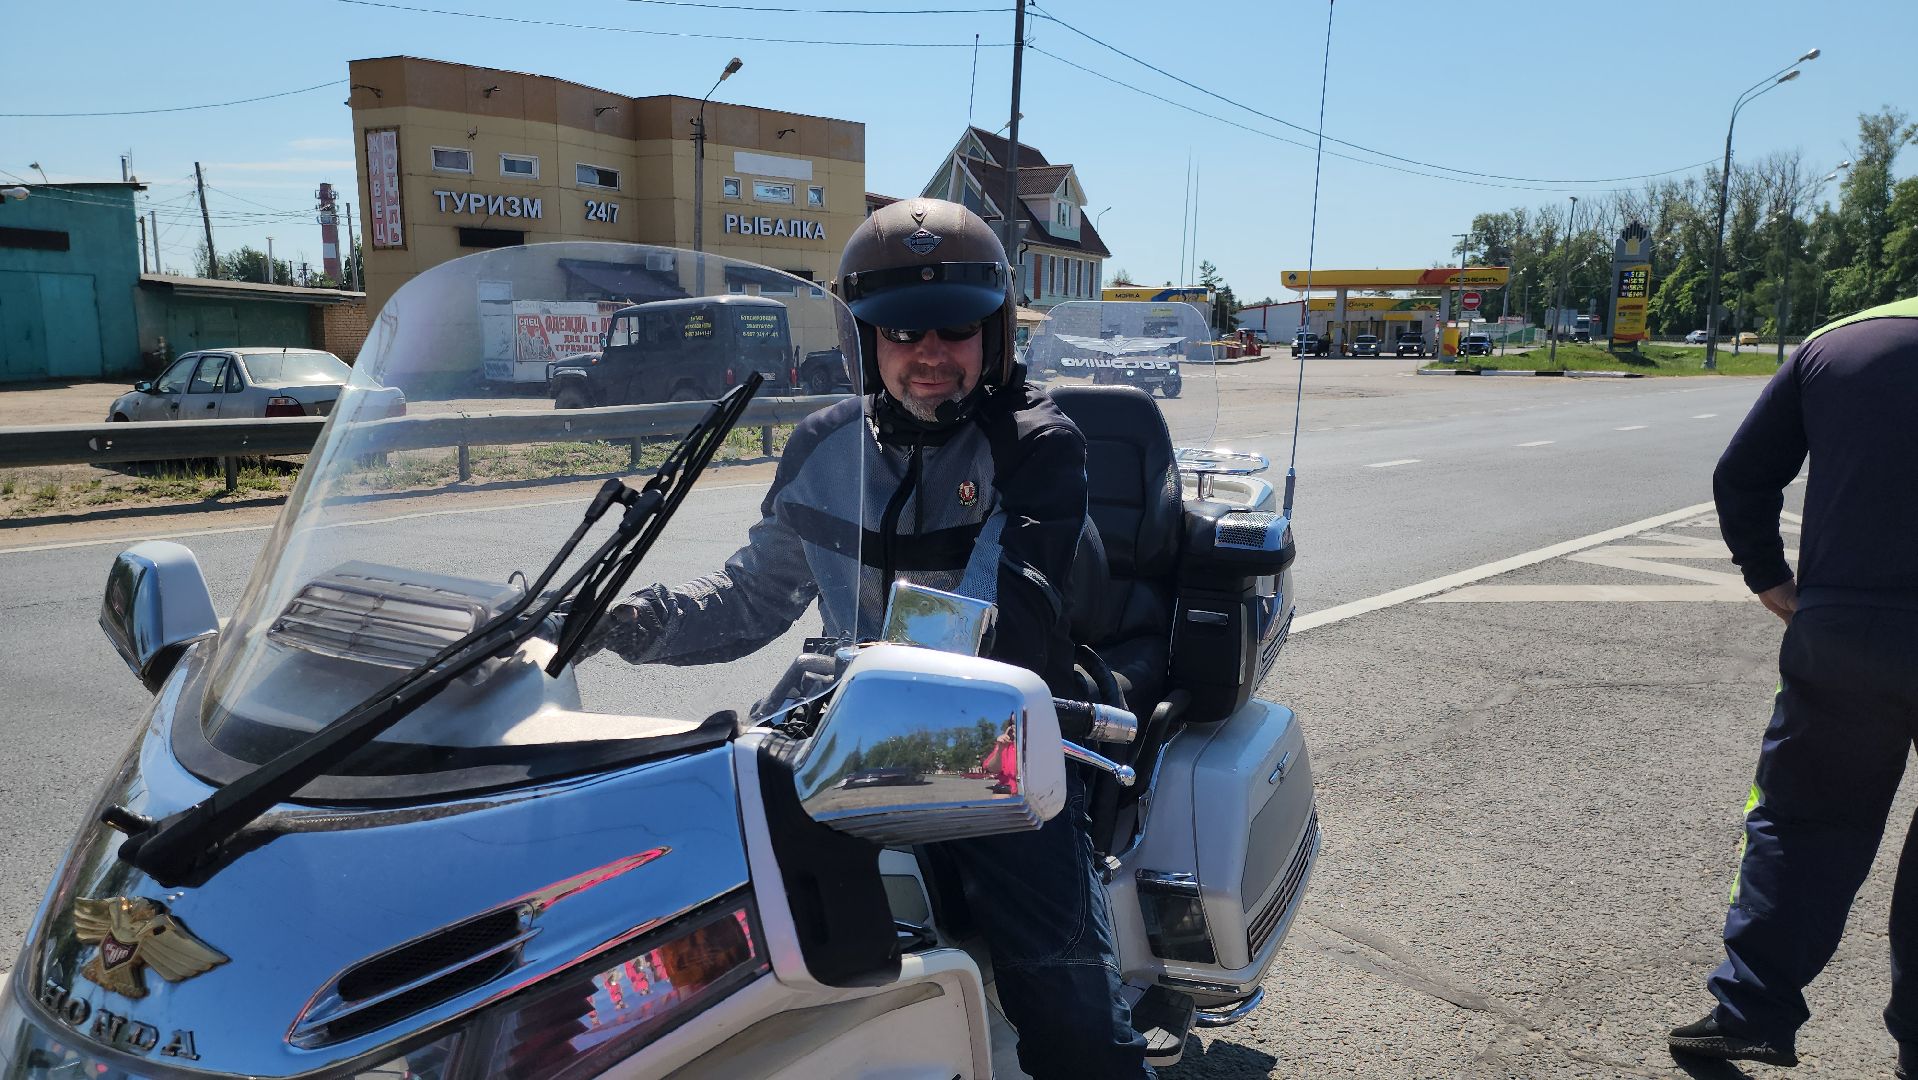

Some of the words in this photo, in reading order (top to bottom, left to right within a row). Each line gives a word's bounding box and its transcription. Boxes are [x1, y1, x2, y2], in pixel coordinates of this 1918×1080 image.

[368, 134, 387, 244] ЖИВЕЦ
[383, 134, 400, 243] МОТЫЛЬ
[433, 189, 543, 220] ТУРИЗМ
[584, 199, 620, 224] 24/7
[725, 212, 827, 240] РЫБАЛКА
[519, 317, 540, 328] СПЕЦ
[544, 315, 589, 334] ОДЕЖДА
[40, 977, 201, 1061] HONDA
